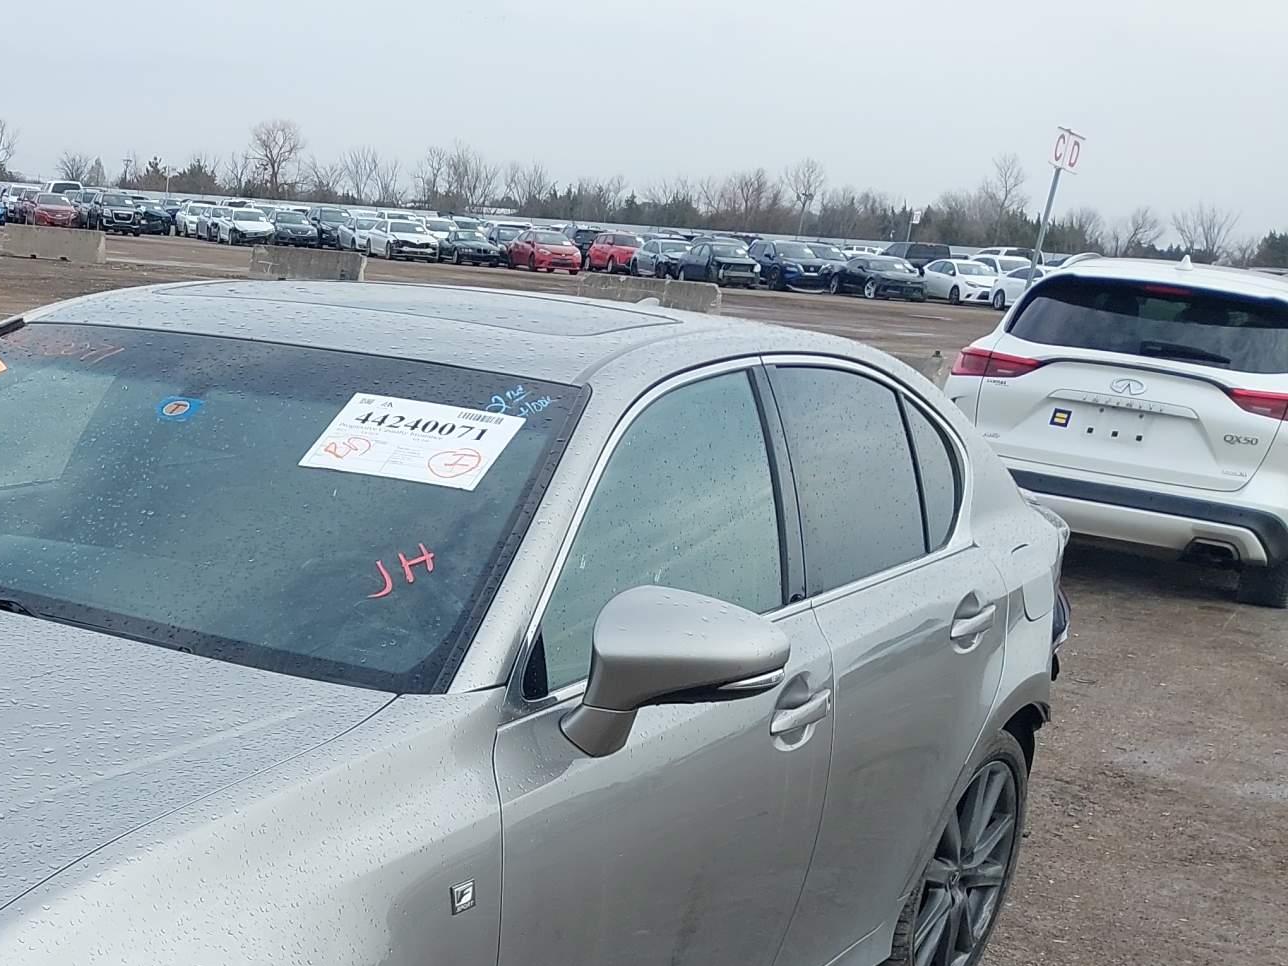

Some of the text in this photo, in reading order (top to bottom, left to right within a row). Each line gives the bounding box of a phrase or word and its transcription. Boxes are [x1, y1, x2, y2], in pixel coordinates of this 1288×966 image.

[1054, 133, 1080, 168] C D
[354, 411, 489, 441] 44240071
[1223, 434, 1259, 446] QX50
